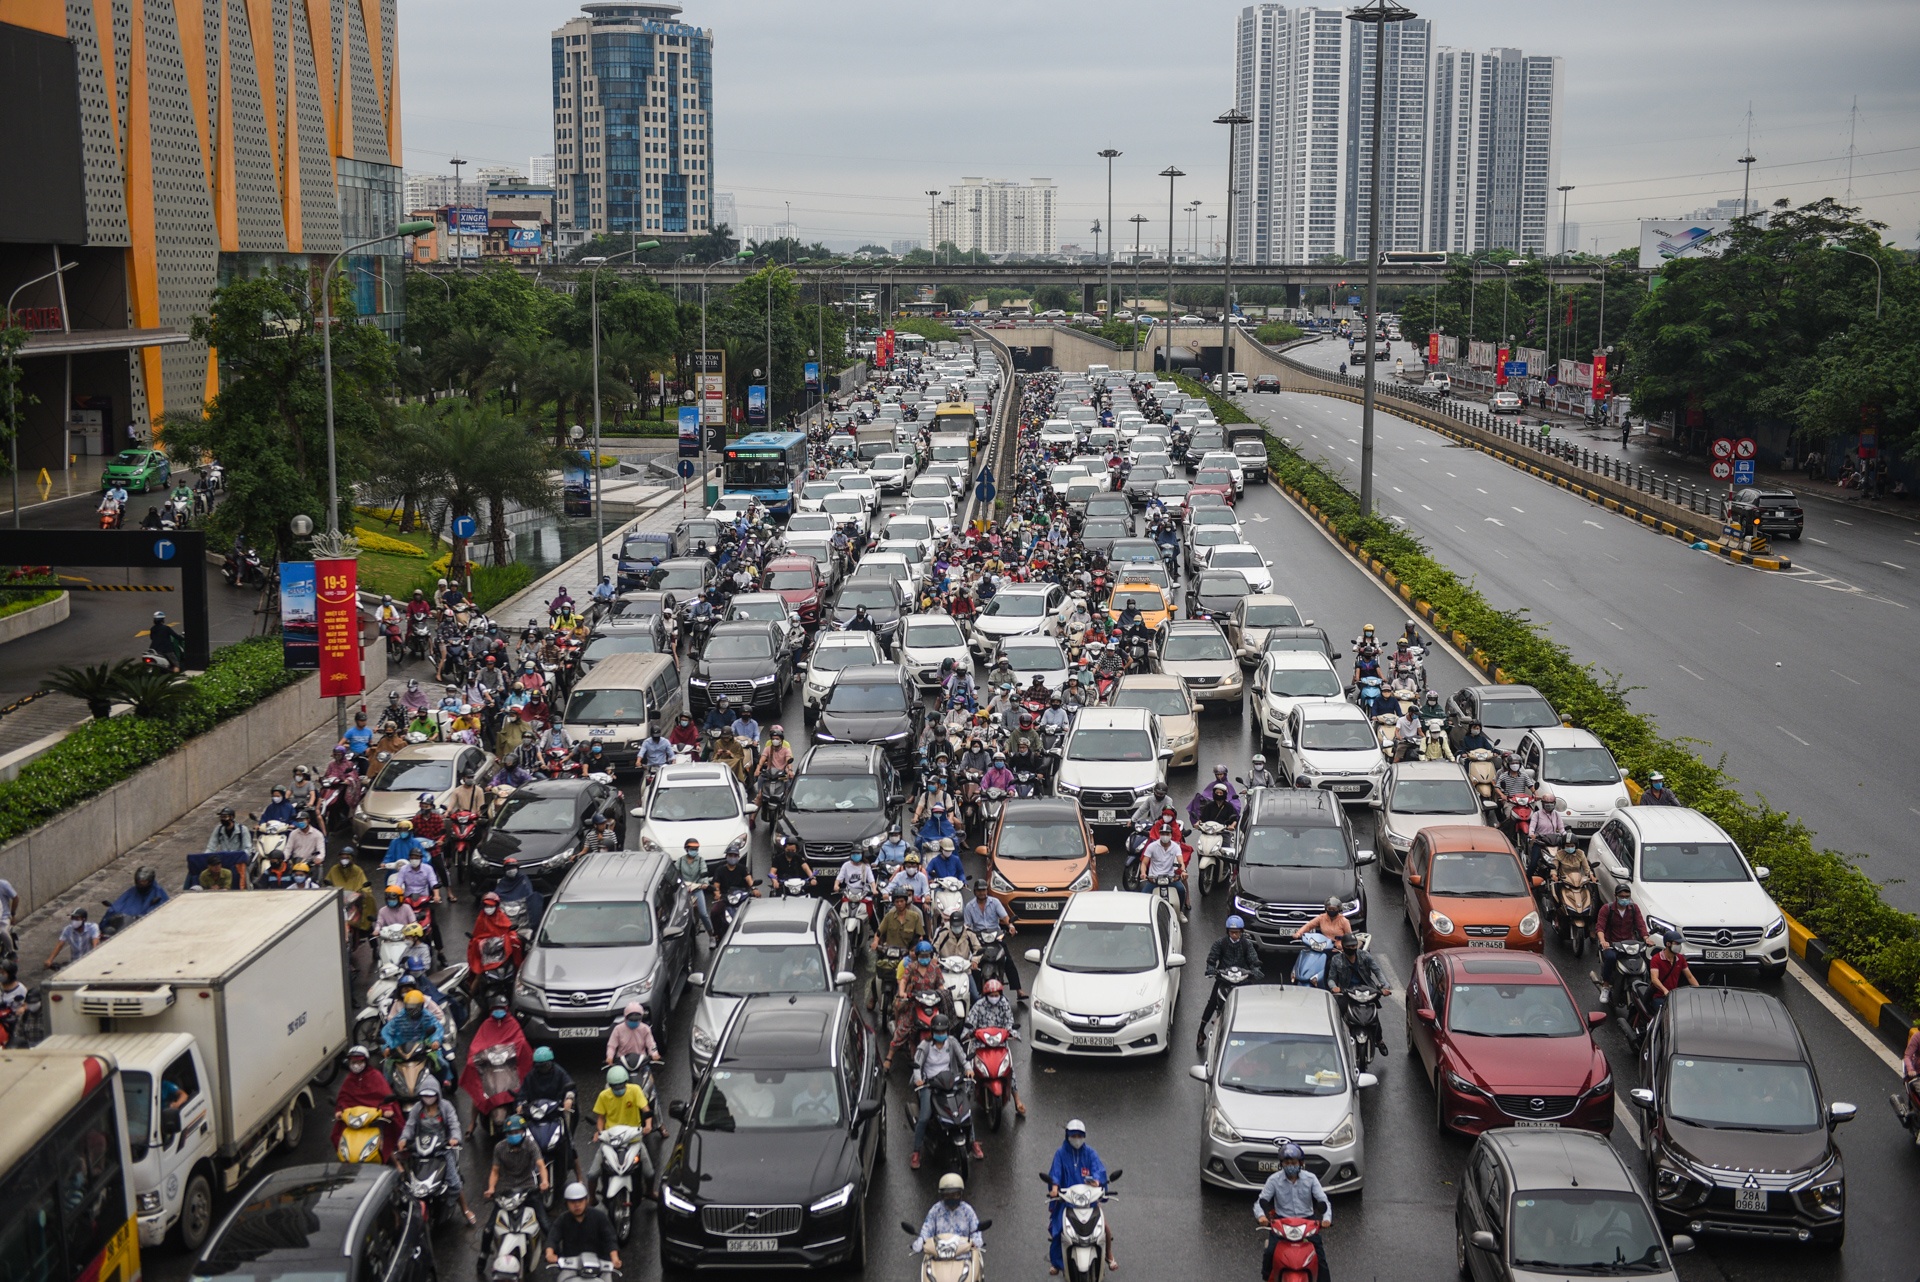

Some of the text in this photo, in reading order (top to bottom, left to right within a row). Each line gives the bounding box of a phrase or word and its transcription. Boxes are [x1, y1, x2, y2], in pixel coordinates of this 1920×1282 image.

[460, 213, 487, 222] XINGFA
[522, 231, 535, 240] SP
[323, 574, 347, 590] 19-5
[588, 728, 616, 736] ZINCA
[1706, 951, 1743, 959] 30E-364.86
[1711, 1163, 1792, 1174] XPANDER
[1743, 1191, 1760, 1201] 28A
[1736, 1200, 1766, 1211] 096.84
[728, 1239, 777, 1251] 30F-561.17
